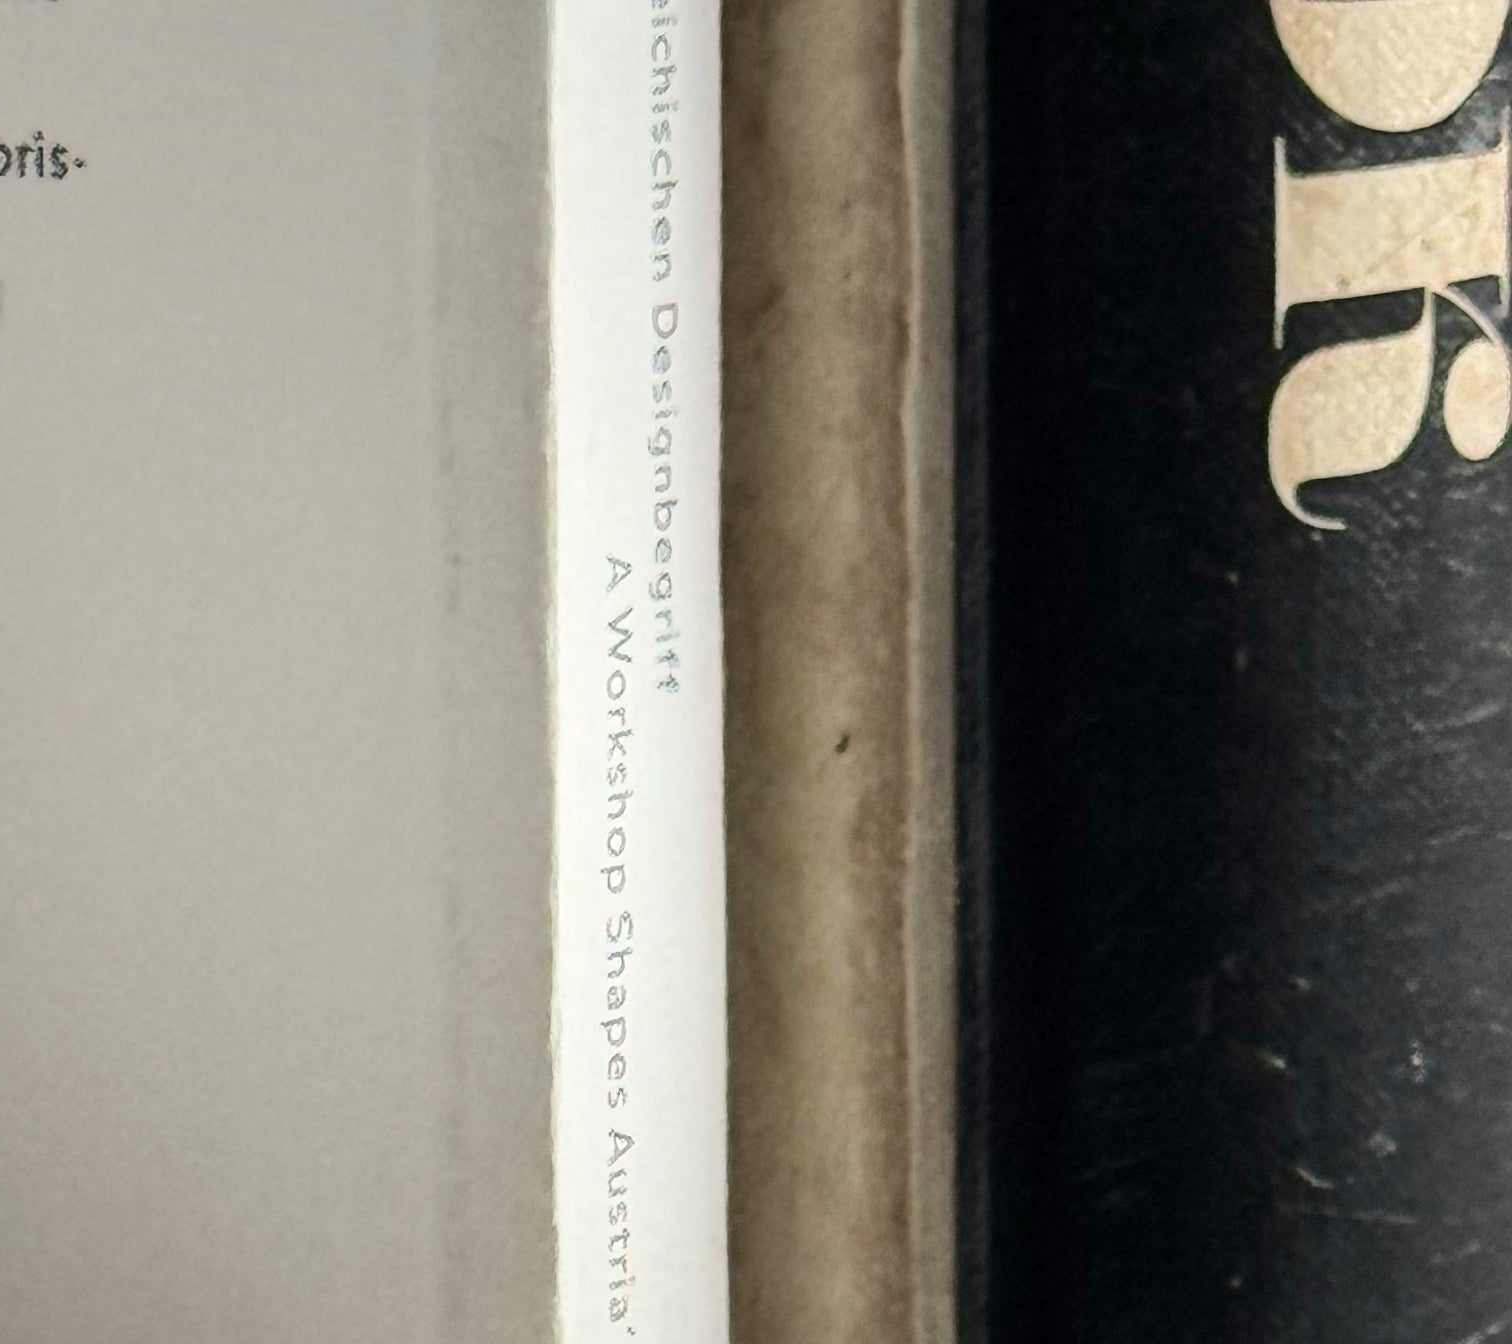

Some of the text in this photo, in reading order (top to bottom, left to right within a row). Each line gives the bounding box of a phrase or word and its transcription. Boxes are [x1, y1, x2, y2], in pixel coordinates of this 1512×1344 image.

[605, 552, 633, 593] A
[648, 302, 680, 694] Designbegriff
[600, 606, 634, 895] Workshop
[600, 910, 634, 1110] Shapes
